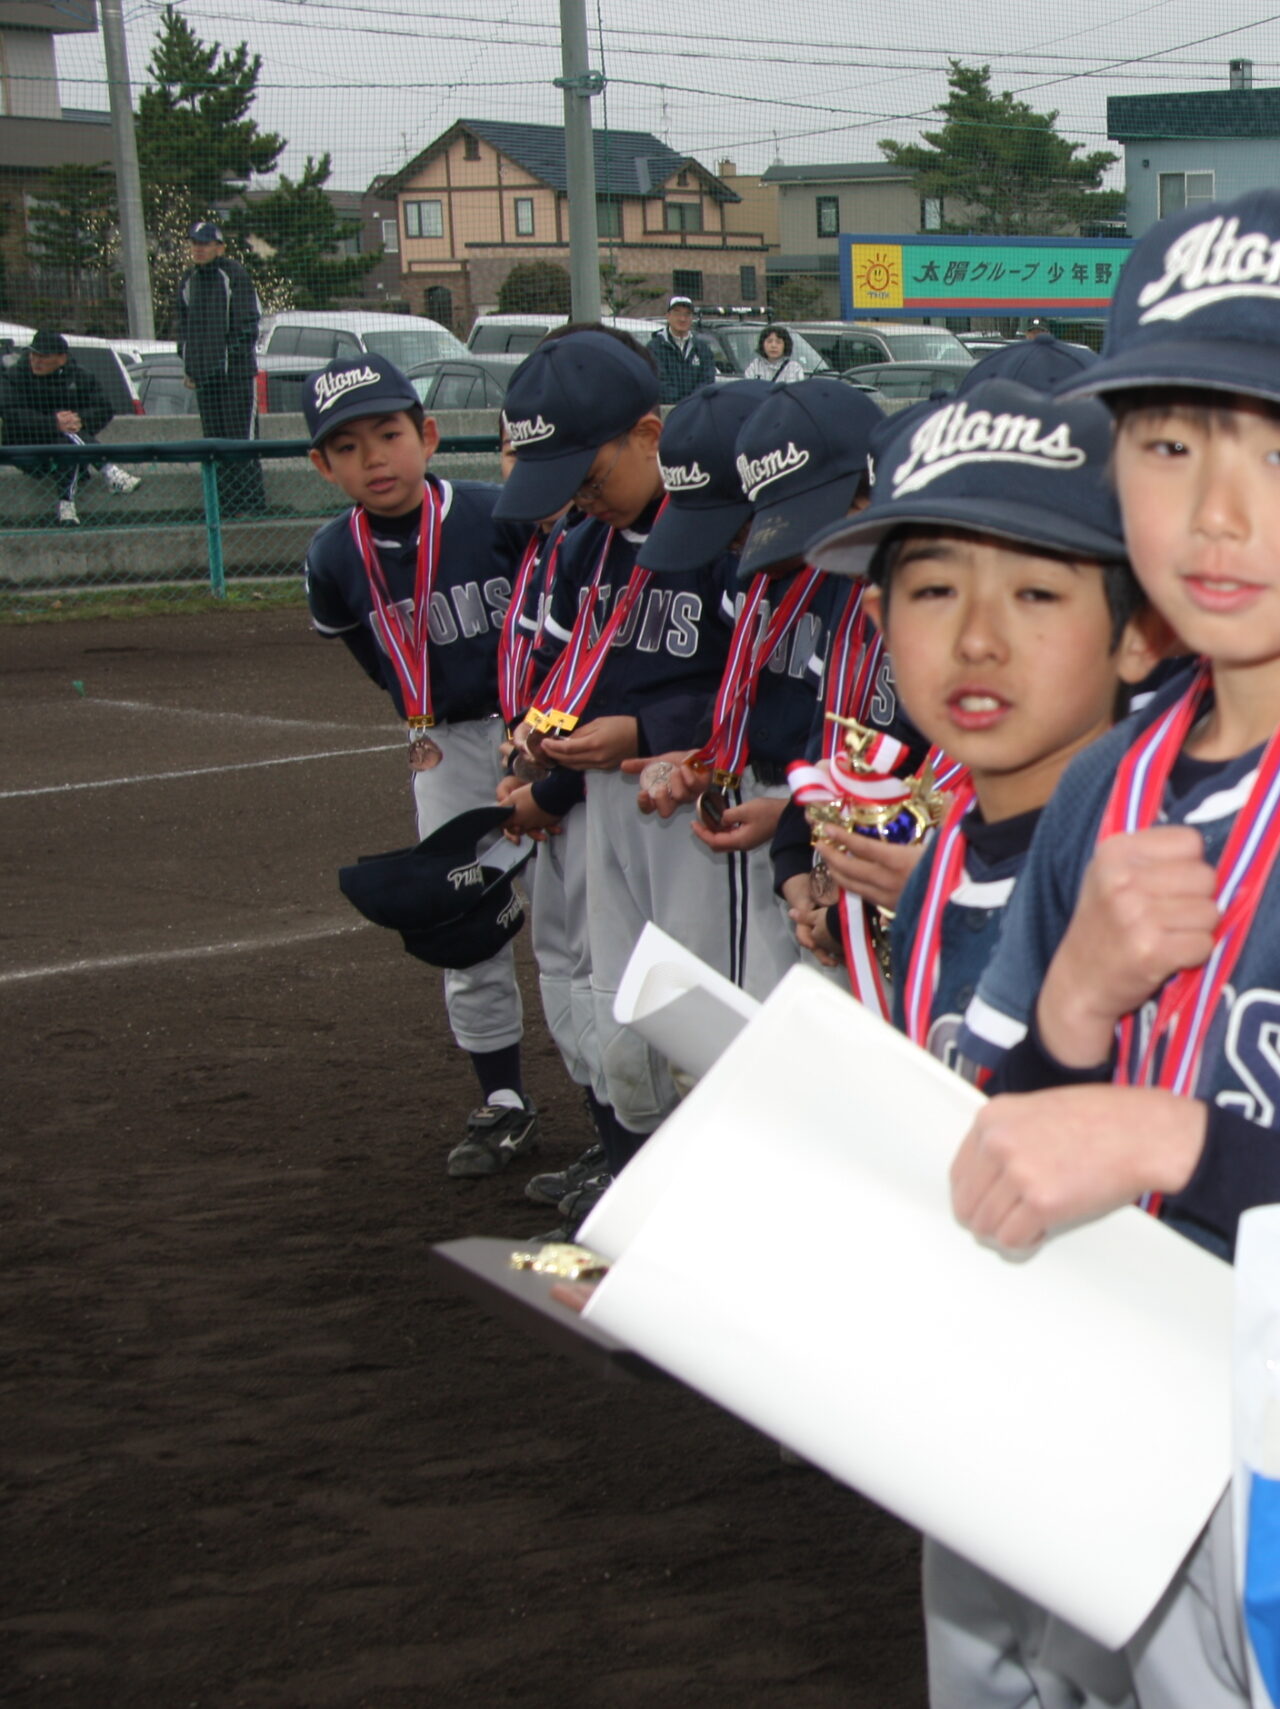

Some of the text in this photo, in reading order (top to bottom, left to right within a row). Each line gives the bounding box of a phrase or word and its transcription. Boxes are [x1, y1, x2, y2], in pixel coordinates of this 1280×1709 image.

[912, 260, 1128, 286] 太陽グループ 少年野
[314, 366, 381, 413] Atoms
[891, 401, 1086, 499] Atoms
